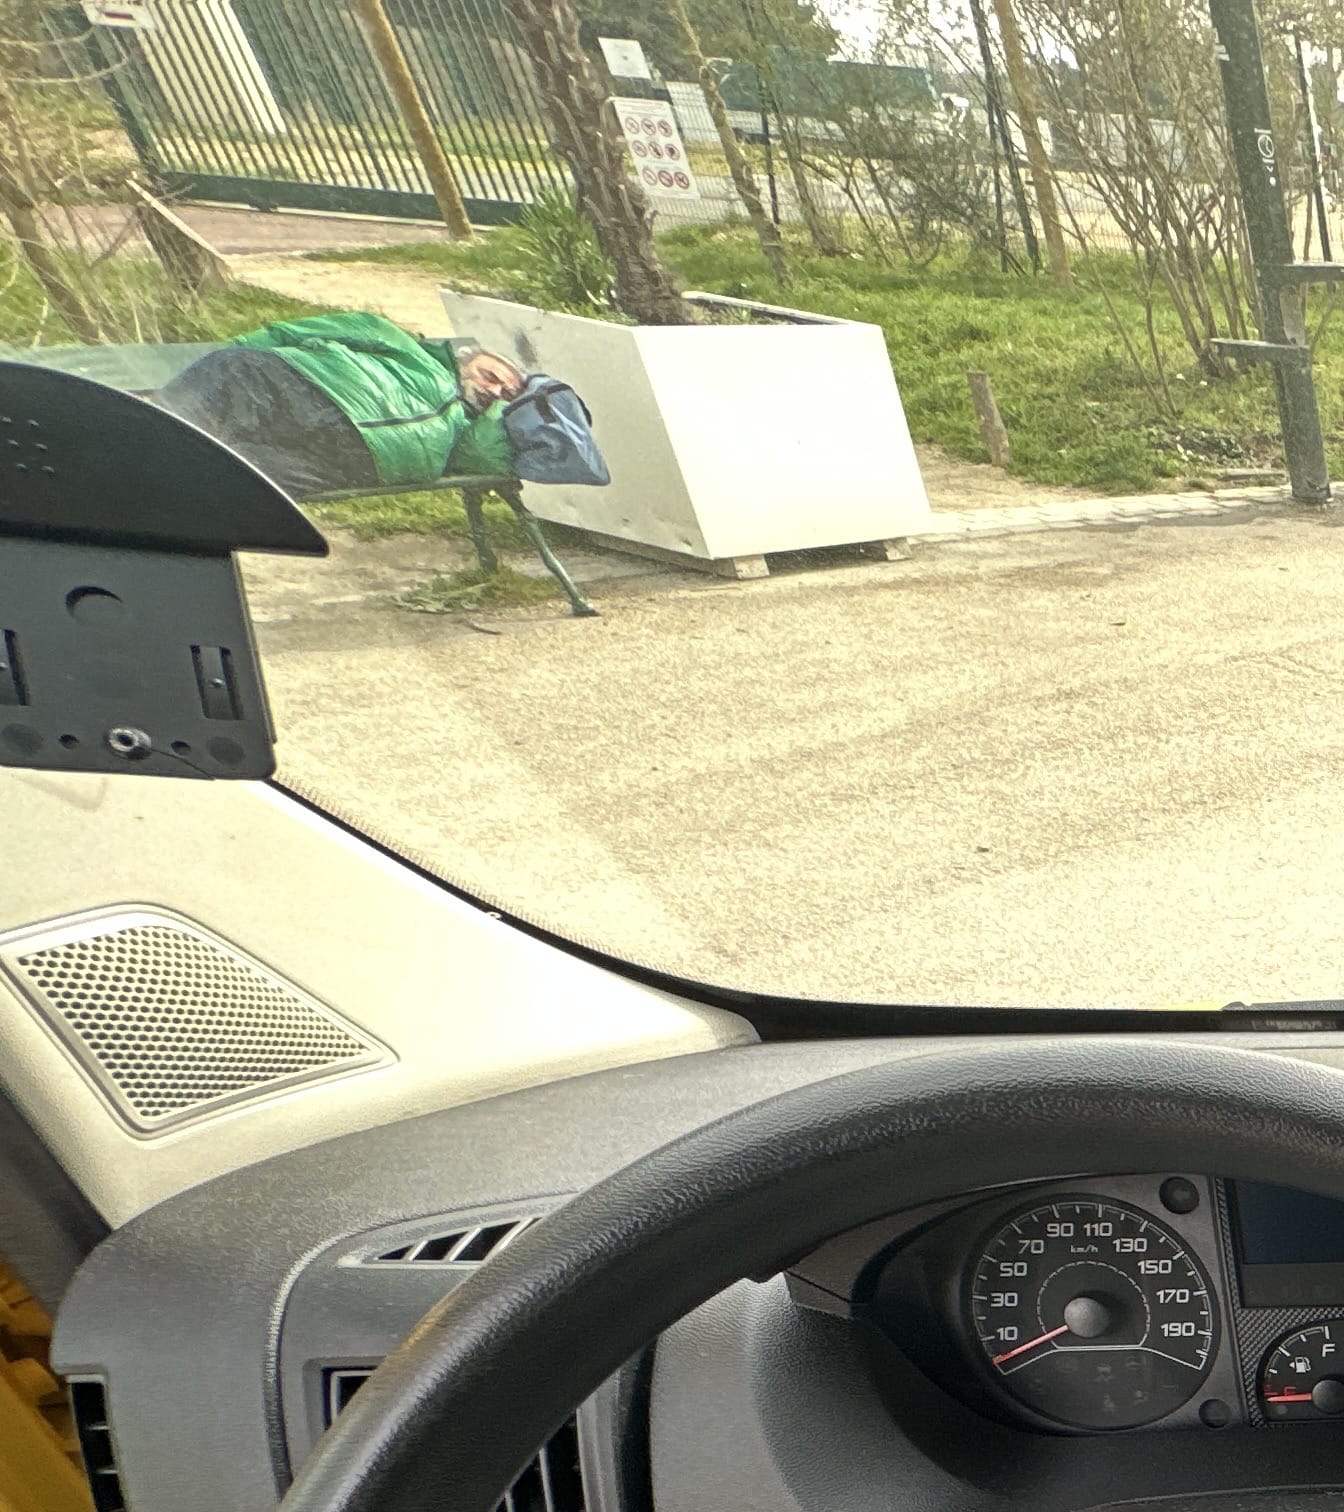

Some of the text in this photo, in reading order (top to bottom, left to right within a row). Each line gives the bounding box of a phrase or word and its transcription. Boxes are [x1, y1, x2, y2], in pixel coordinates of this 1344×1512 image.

[1047, 1223, 1074, 1237] 90
[1083, 1222, 1112, 1237] 110
[1018, 1239, 1044, 1254] 70
[1070, 1244, 1098, 1253] km/h
[1112, 1238, 1147, 1253] 130
[1000, 1262, 1027, 1277] 50
[1137, 1259, 1172, 1274] 150
[991, 1292, 1018, 1307] 30
[1156, 1288, 1189, 1304] 170
[996, 1326, 1018, 1341] 10
[1161, 1322, 1195, 1337] 190
[1322, 1343, 1336, 1358] F
